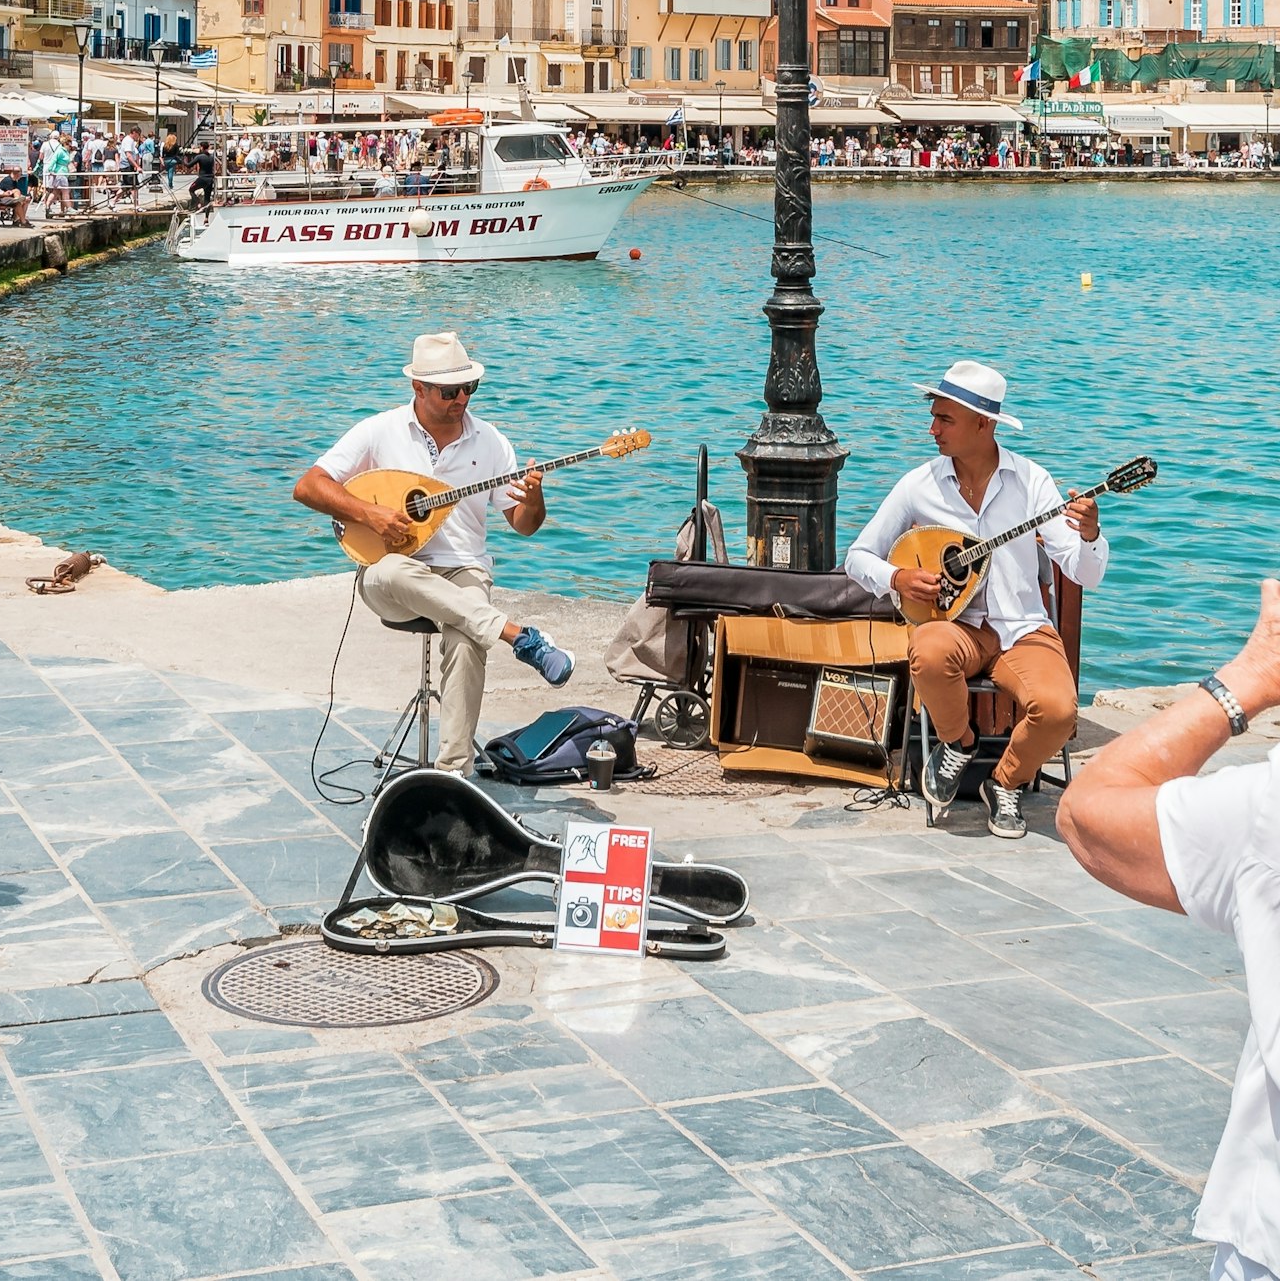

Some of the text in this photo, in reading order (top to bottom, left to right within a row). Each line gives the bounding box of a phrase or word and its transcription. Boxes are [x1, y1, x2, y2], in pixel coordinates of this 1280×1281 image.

[1062, 101, 1101, 113] PADRINO
[598, 182, 639, 195] EROFILI
[303, 208, 330, 216] BOAT
[360, 206, 385, 214] WITH
[450, 203, 482, 211] GLASS
[485, 200, 525, 209] BOTTOM
[241, 225, 335, 243] GLASS
[469, 214, 543, 236] BOAT
[825, 671, 849, 684] VOX
[777, 680, 807, 690] FISHMAN
[611, 833, 646, 849] FREE
[606, 885, 643, 903] TIPS
